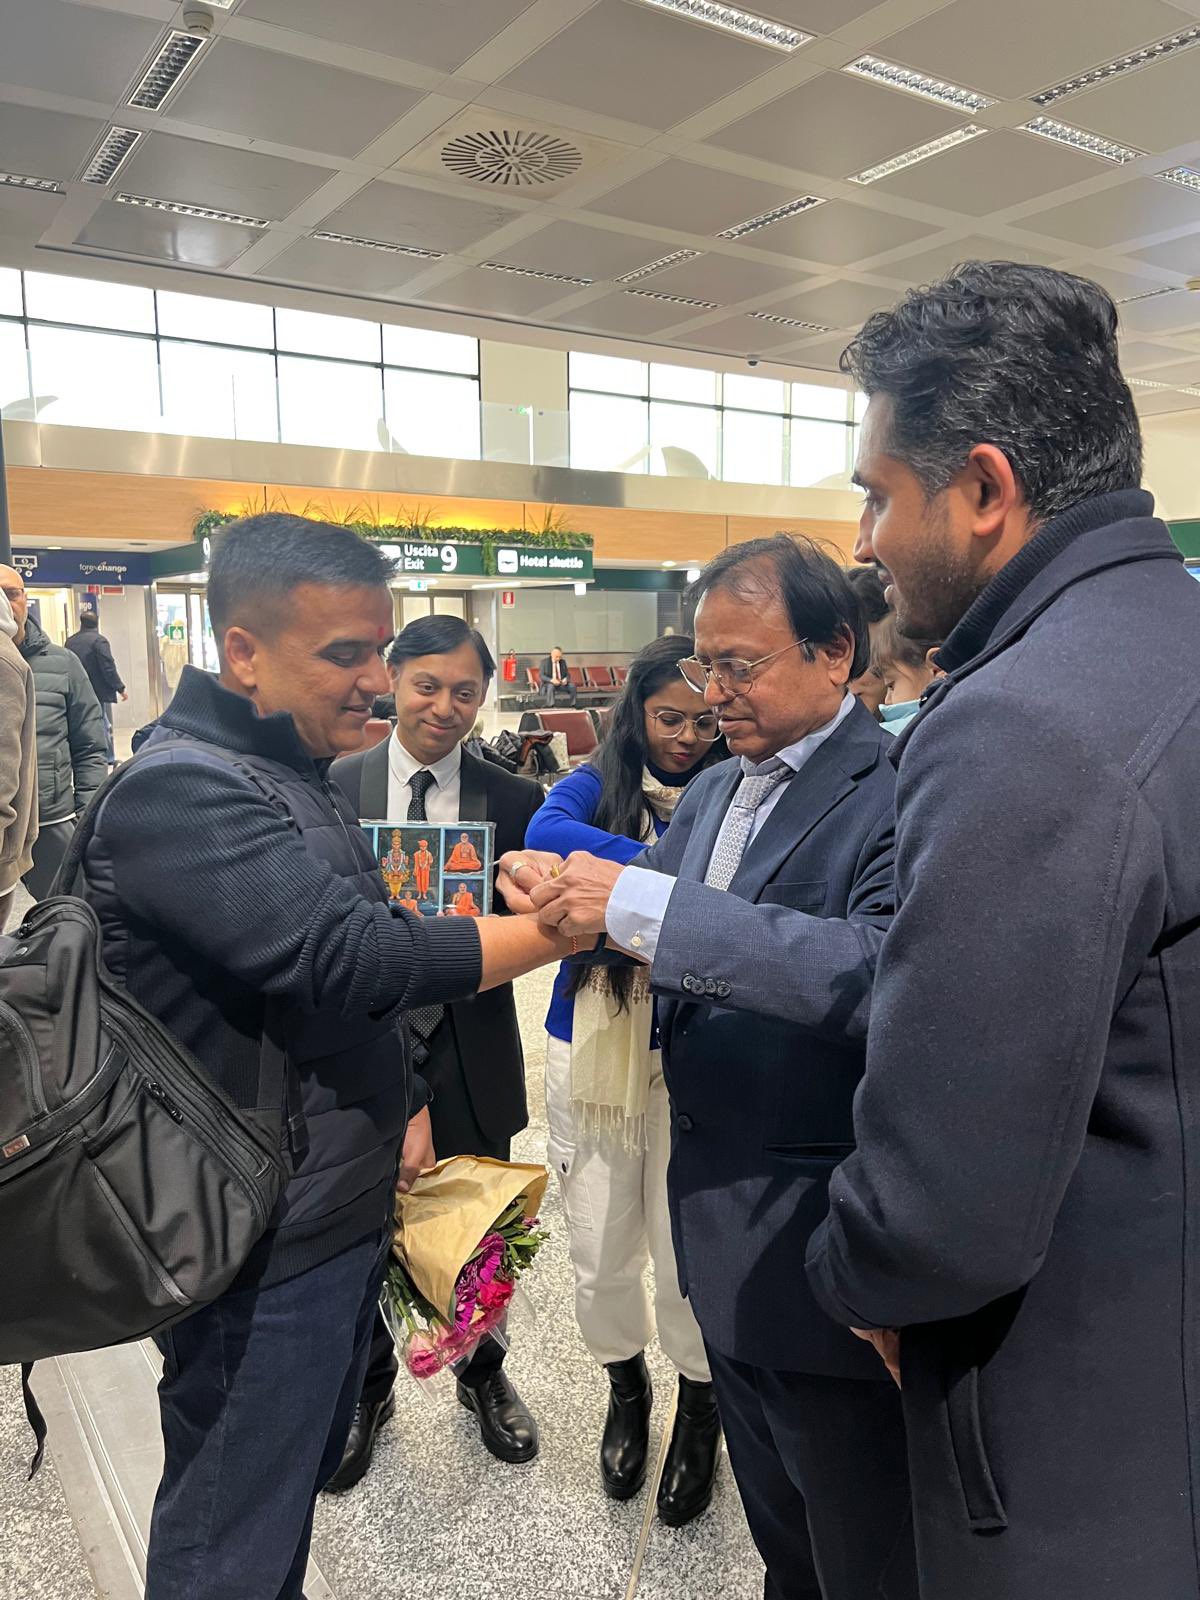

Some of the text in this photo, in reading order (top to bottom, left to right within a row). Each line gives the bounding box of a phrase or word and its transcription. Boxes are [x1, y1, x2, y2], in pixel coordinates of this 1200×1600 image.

[404, 544, 439, 557] Uscita
[404, 558, 425, 570] Exit
[440, 545, 458, 572] 9
[520, 555, 584, 569] Hotel shuttle
